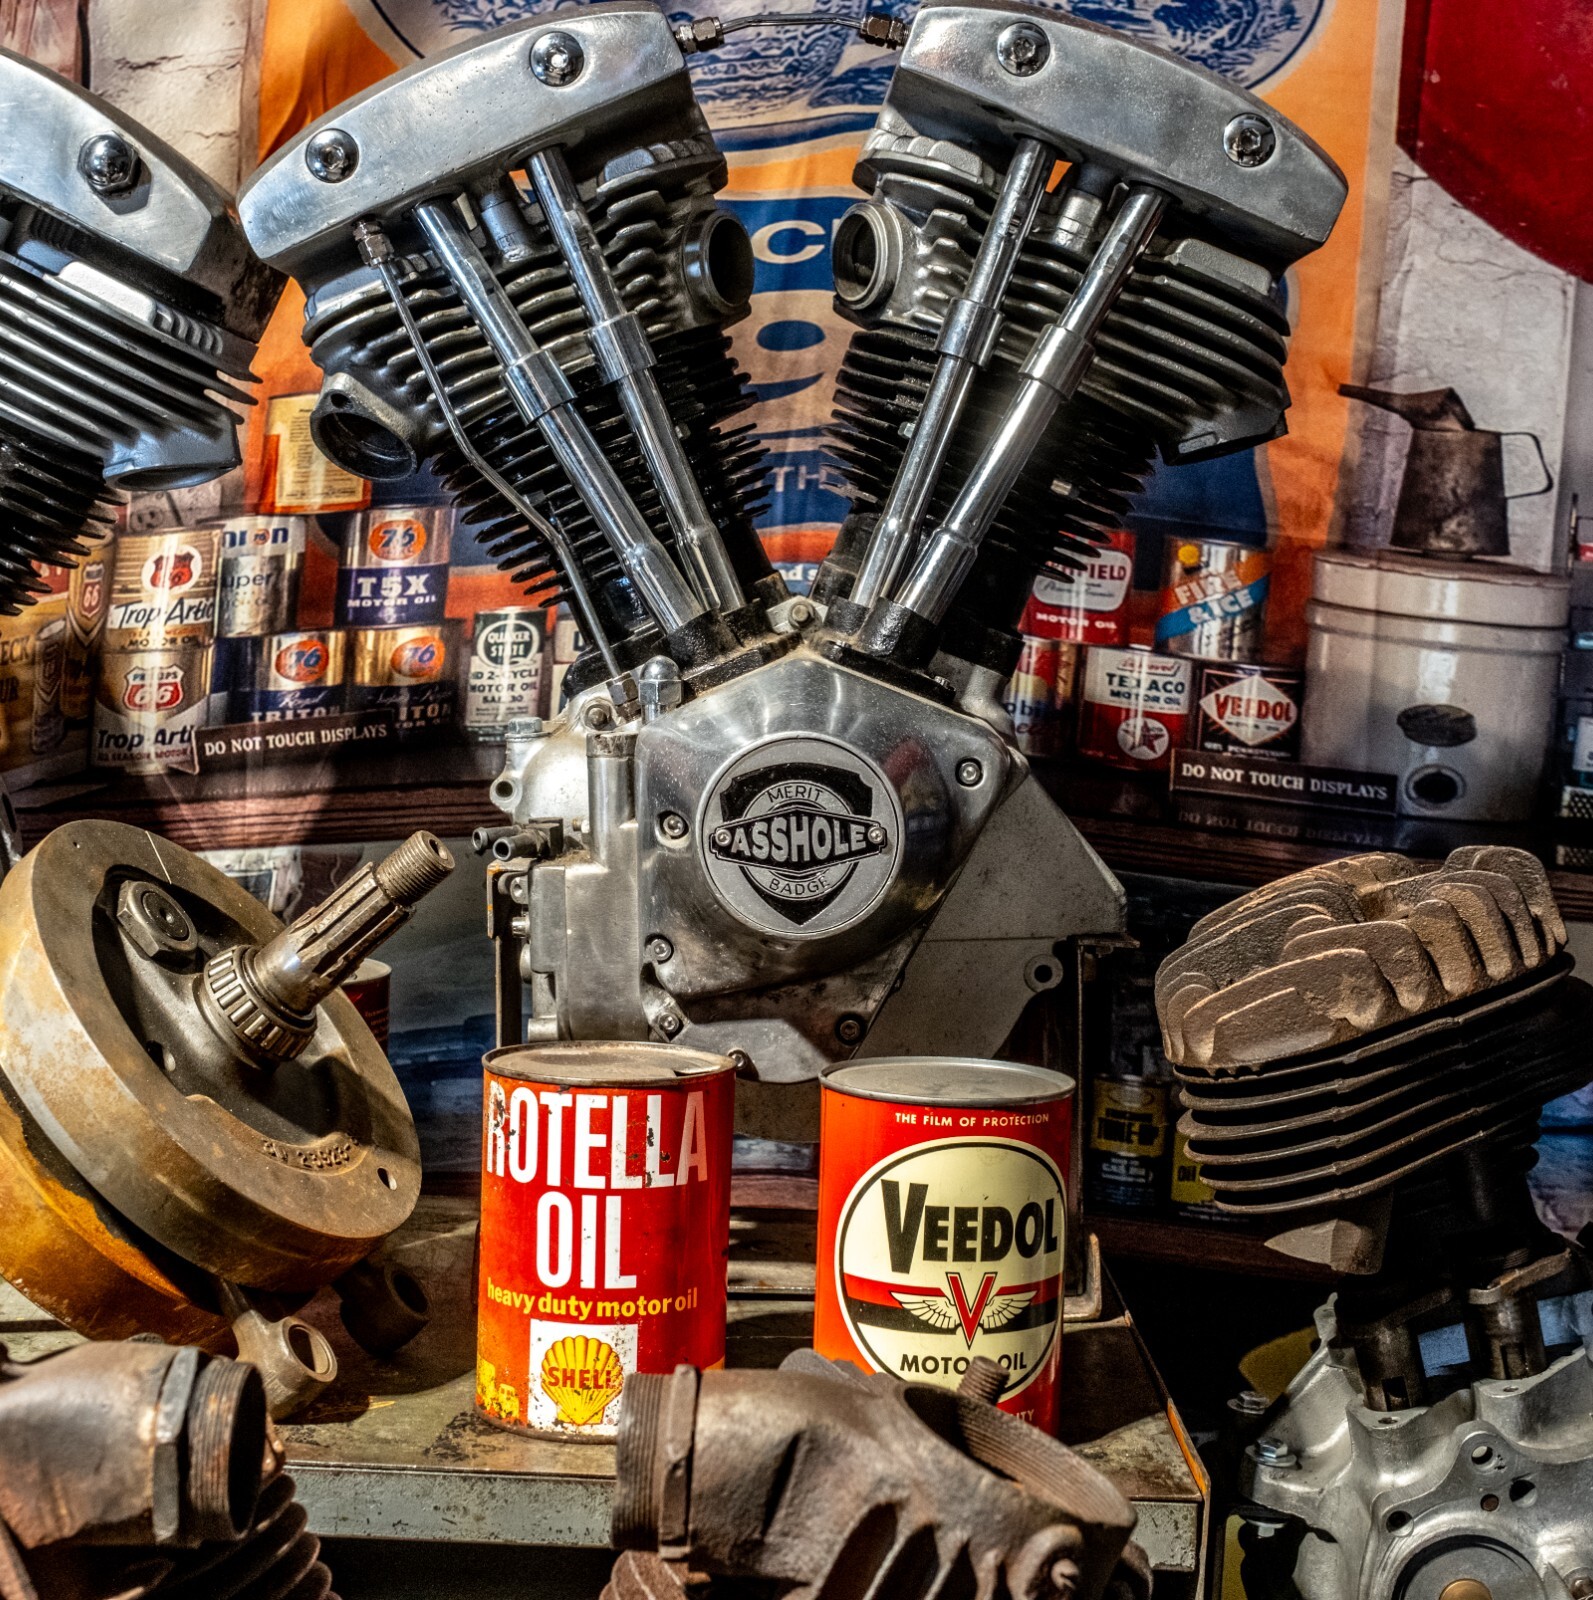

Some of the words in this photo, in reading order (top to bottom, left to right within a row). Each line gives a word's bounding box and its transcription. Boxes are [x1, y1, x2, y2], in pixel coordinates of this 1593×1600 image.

[381, 527, 415, 547] 76
[83, 584, 99, 607] 66
[357, 573, 429, 597] T5X
[1174, 570, 1242, 605] FIRE
[347, 598, 408, 607] MOTOR
[1036, 612, 1089, 627] MOTOR
[490, 644, 524, 657] STTE
[134, 685, 173, 704] 66
[204, 741, 225, 756] DO
[231, 737, 262, 753] NOT
[266, 731, 315, 749] TOUCH
[321, 724, 387, 743] DISPLAYS
[1182, 763, 1205, 778] DO
[1211, 767, 1244, 783] NOT
[1249, 772, 1304, 790] TOUCH
[1310, 778, 1388, 800] DISPLAYS
[767, 785, 824, 803] MERIT
[731, 815, 867, 862] ASSHOLE
[769, 875, 830, 896] BADGE
[895, 1112, 917, 1124] THE
[923, 1114, 953, 1126] FILM
[959, 1117, 976, 1127] OF
[983, 1113, 1049, 1127] PROTECTION
[486, 1081, 708, 1189] ROTELLA
[881, 1179, 1058, 1274] VEEDOL
[536, 1191, 637, 1289] OIL
[487, 1277, 535, 1314] heavy
[538, 1292, 592, 1320] duty
[597, 1295, 672, 1317] motor
[675, 1287, 698, 1311] oil
[900, 1354, 970, 1375] MOTO
[997, 1352, 1027, 1371] OIL
[547, 1367, 616, 1389] SHELL
